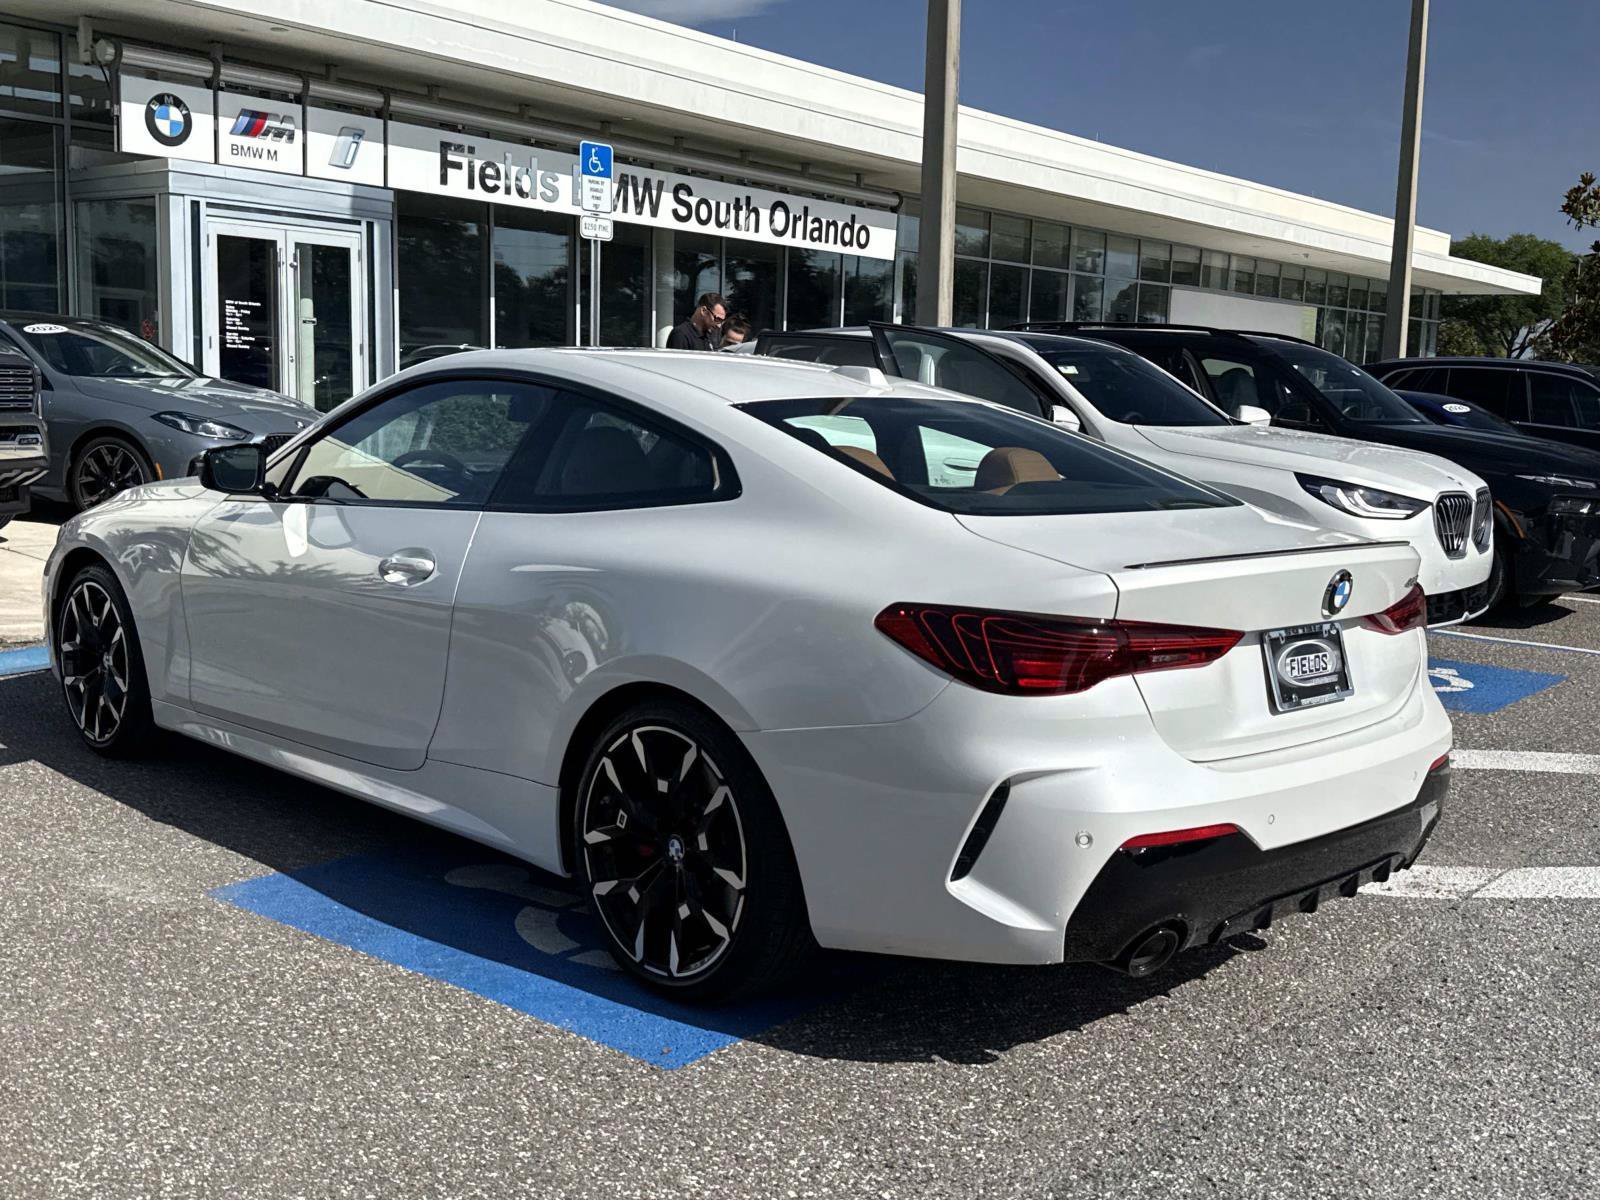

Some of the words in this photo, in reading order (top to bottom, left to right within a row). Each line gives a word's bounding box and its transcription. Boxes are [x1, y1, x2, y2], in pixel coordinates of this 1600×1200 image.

[230, 144, 265, 160] BMW
[266, 150, 278, 162] M
[440, 141, 560, 203] Fields
[671, 182, 760, 234] South
[769, 200, 871, 250] Orlando
[1289, 653, 1329, 677] FIELDS
